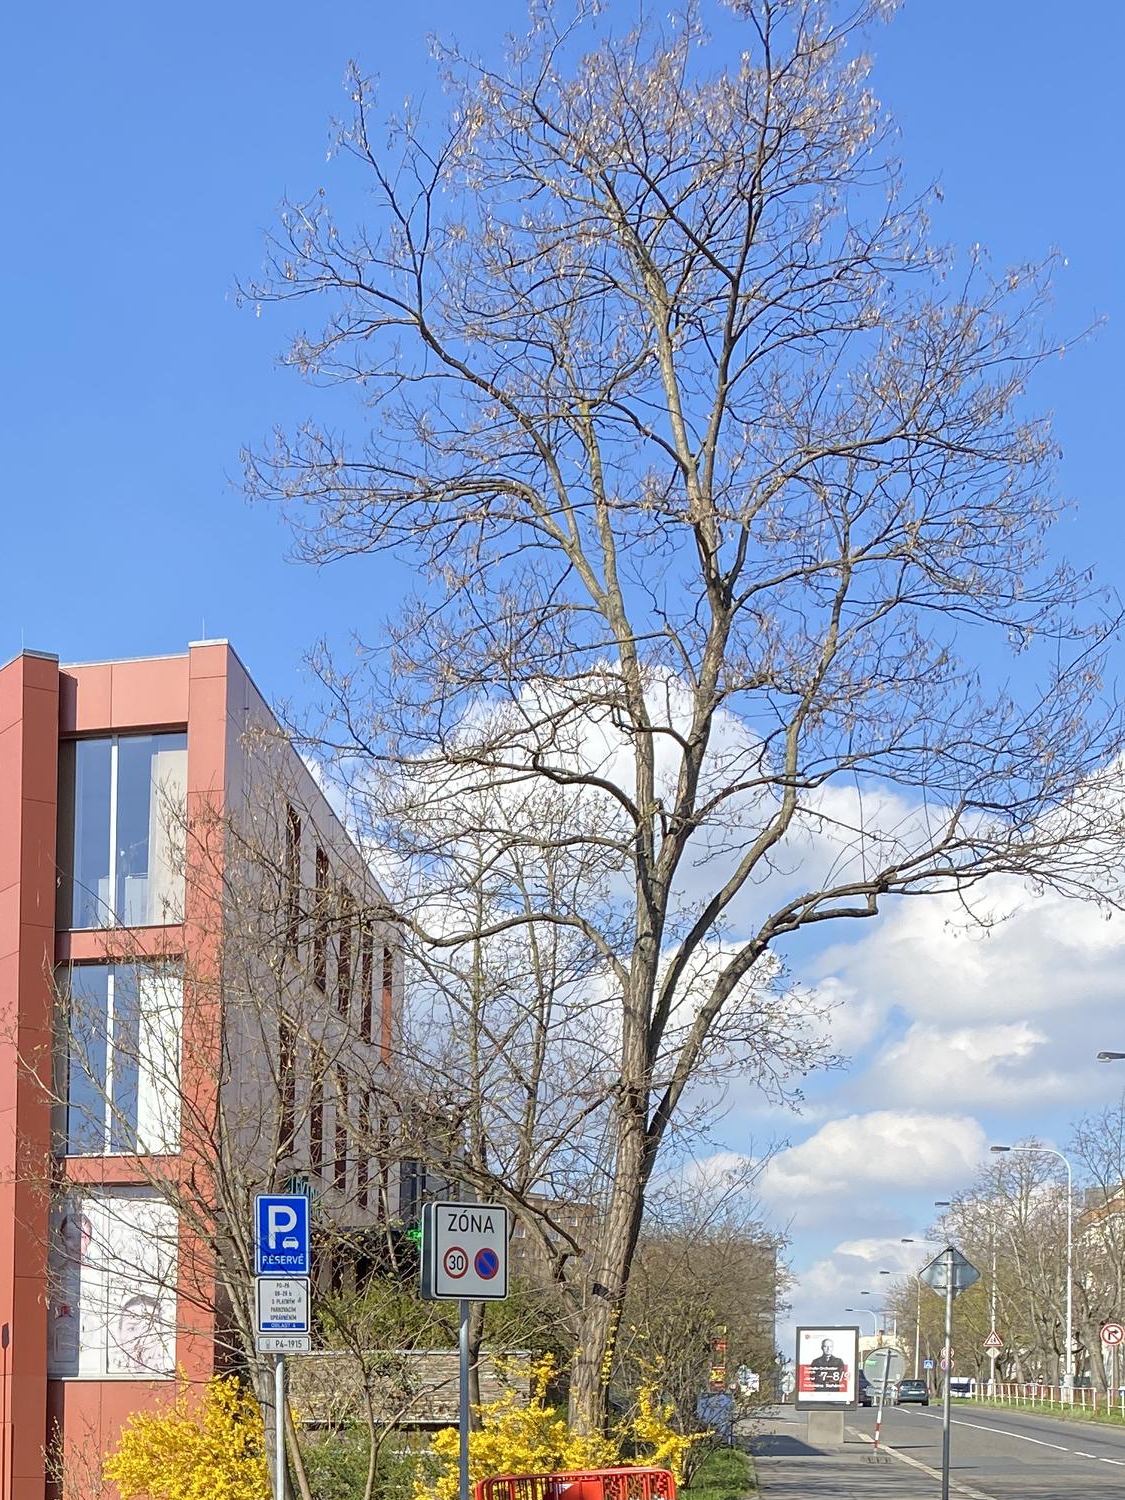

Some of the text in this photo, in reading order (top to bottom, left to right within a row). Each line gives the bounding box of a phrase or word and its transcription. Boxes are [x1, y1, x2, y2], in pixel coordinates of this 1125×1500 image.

[268, 1205, 297, 1249] P
[448, 1209, 495, 1233] ZÓNA
[262, 1253, 304, 1264] RÉSERVÉ
[449, 1255, 464, 1270] 30
[275, 1340, 302, 1348] P4-1915
